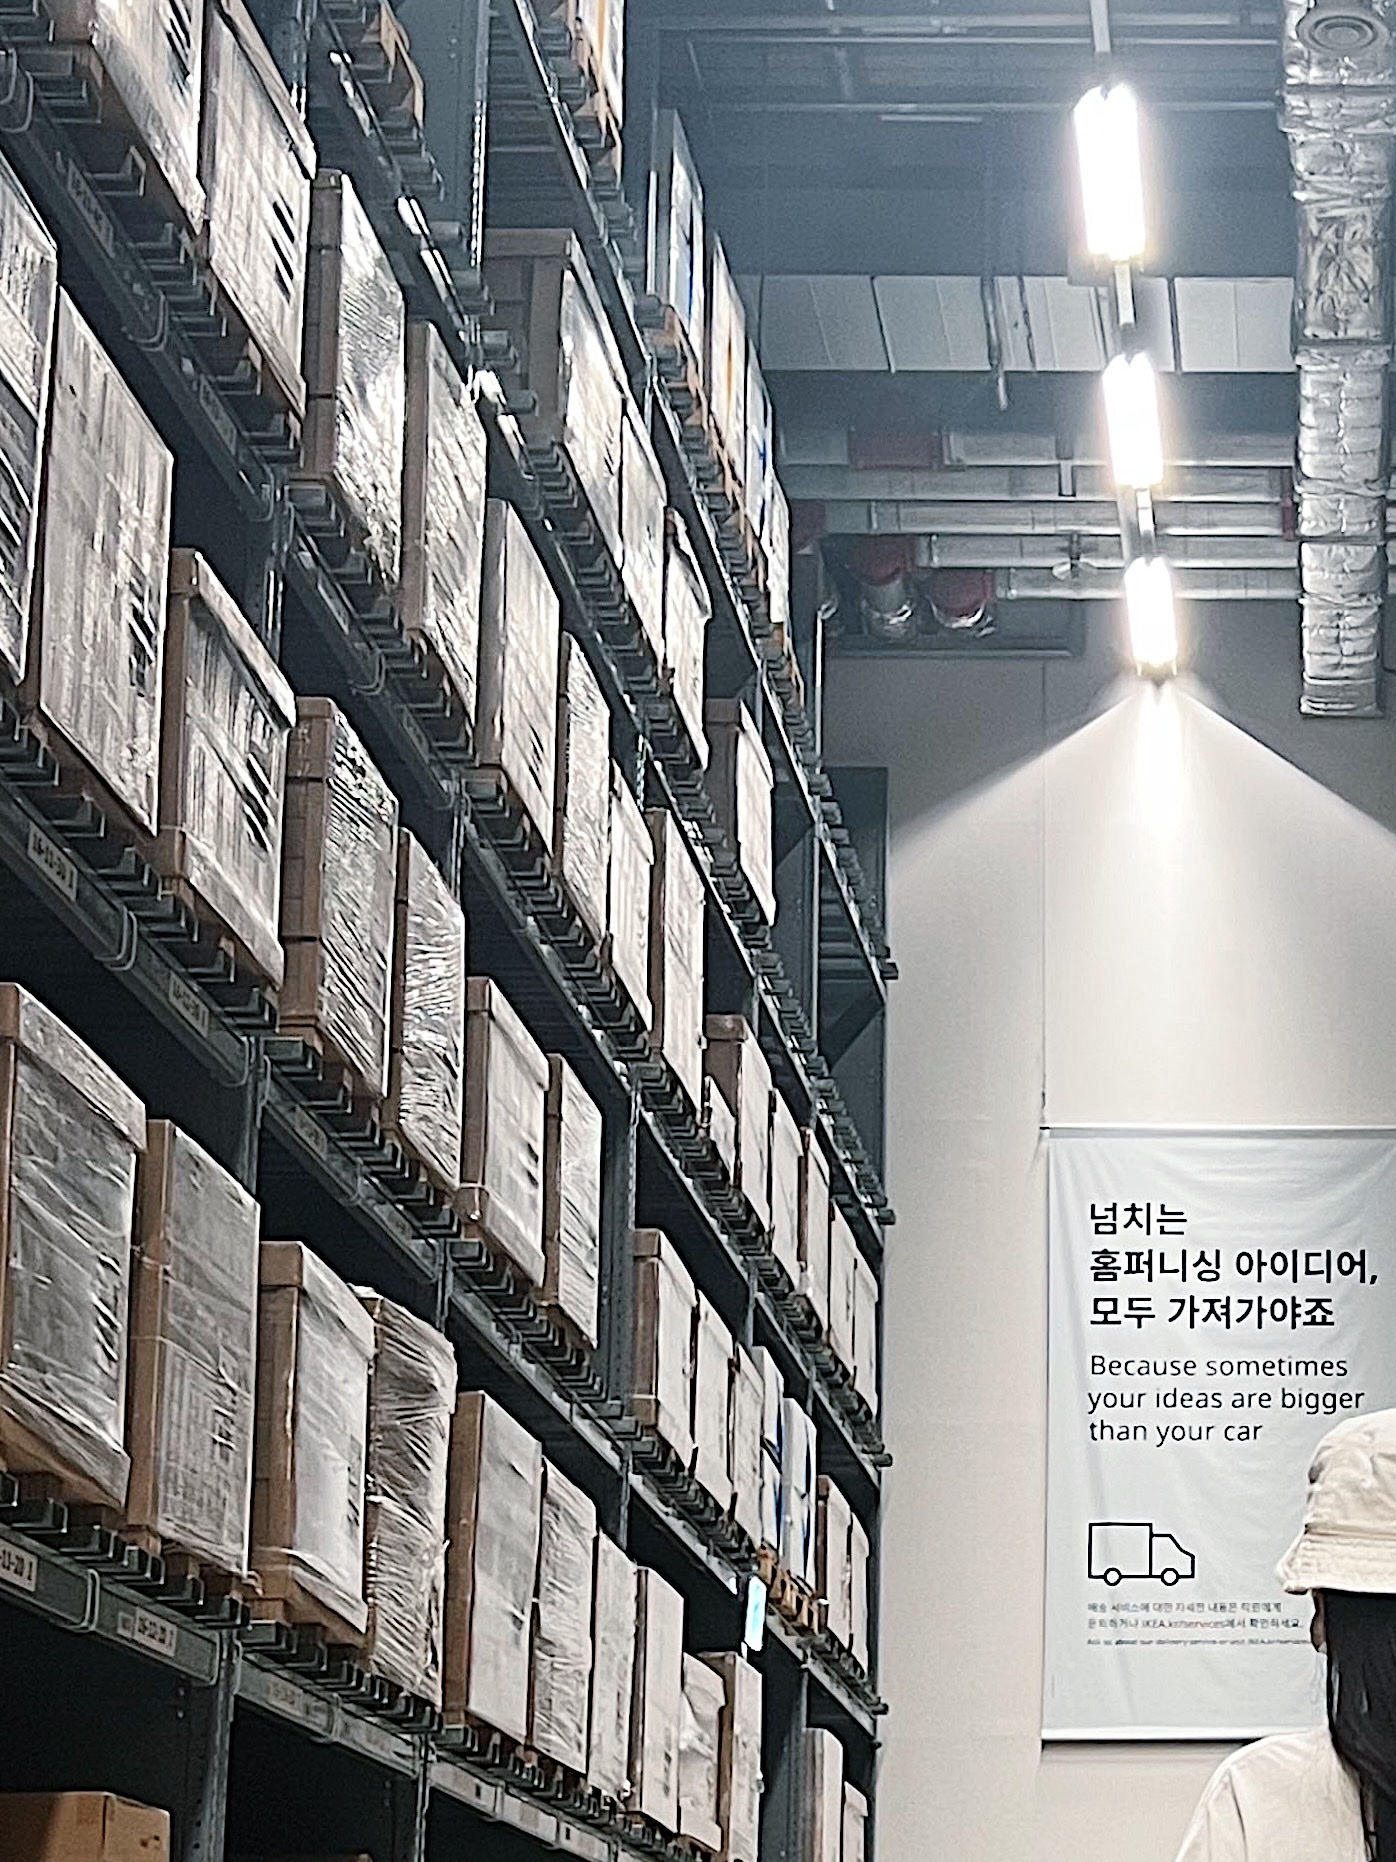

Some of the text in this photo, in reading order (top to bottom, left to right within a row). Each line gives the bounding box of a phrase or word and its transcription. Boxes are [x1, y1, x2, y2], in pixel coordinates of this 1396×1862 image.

[1090, 1202, 1188, 1236] 넘치는
[1090, 1248, 1378, 1286] 홈퍼니싱 아이디어,
[1090, 1295, 1336, 1330] 모두 가져가야죠
[1091, 1355, 1349, 1377] Because sometimes
[1087, 1387, 1365, 1415] your ideas are bigger
[1089, 1419, 1264, 1448] than your car
